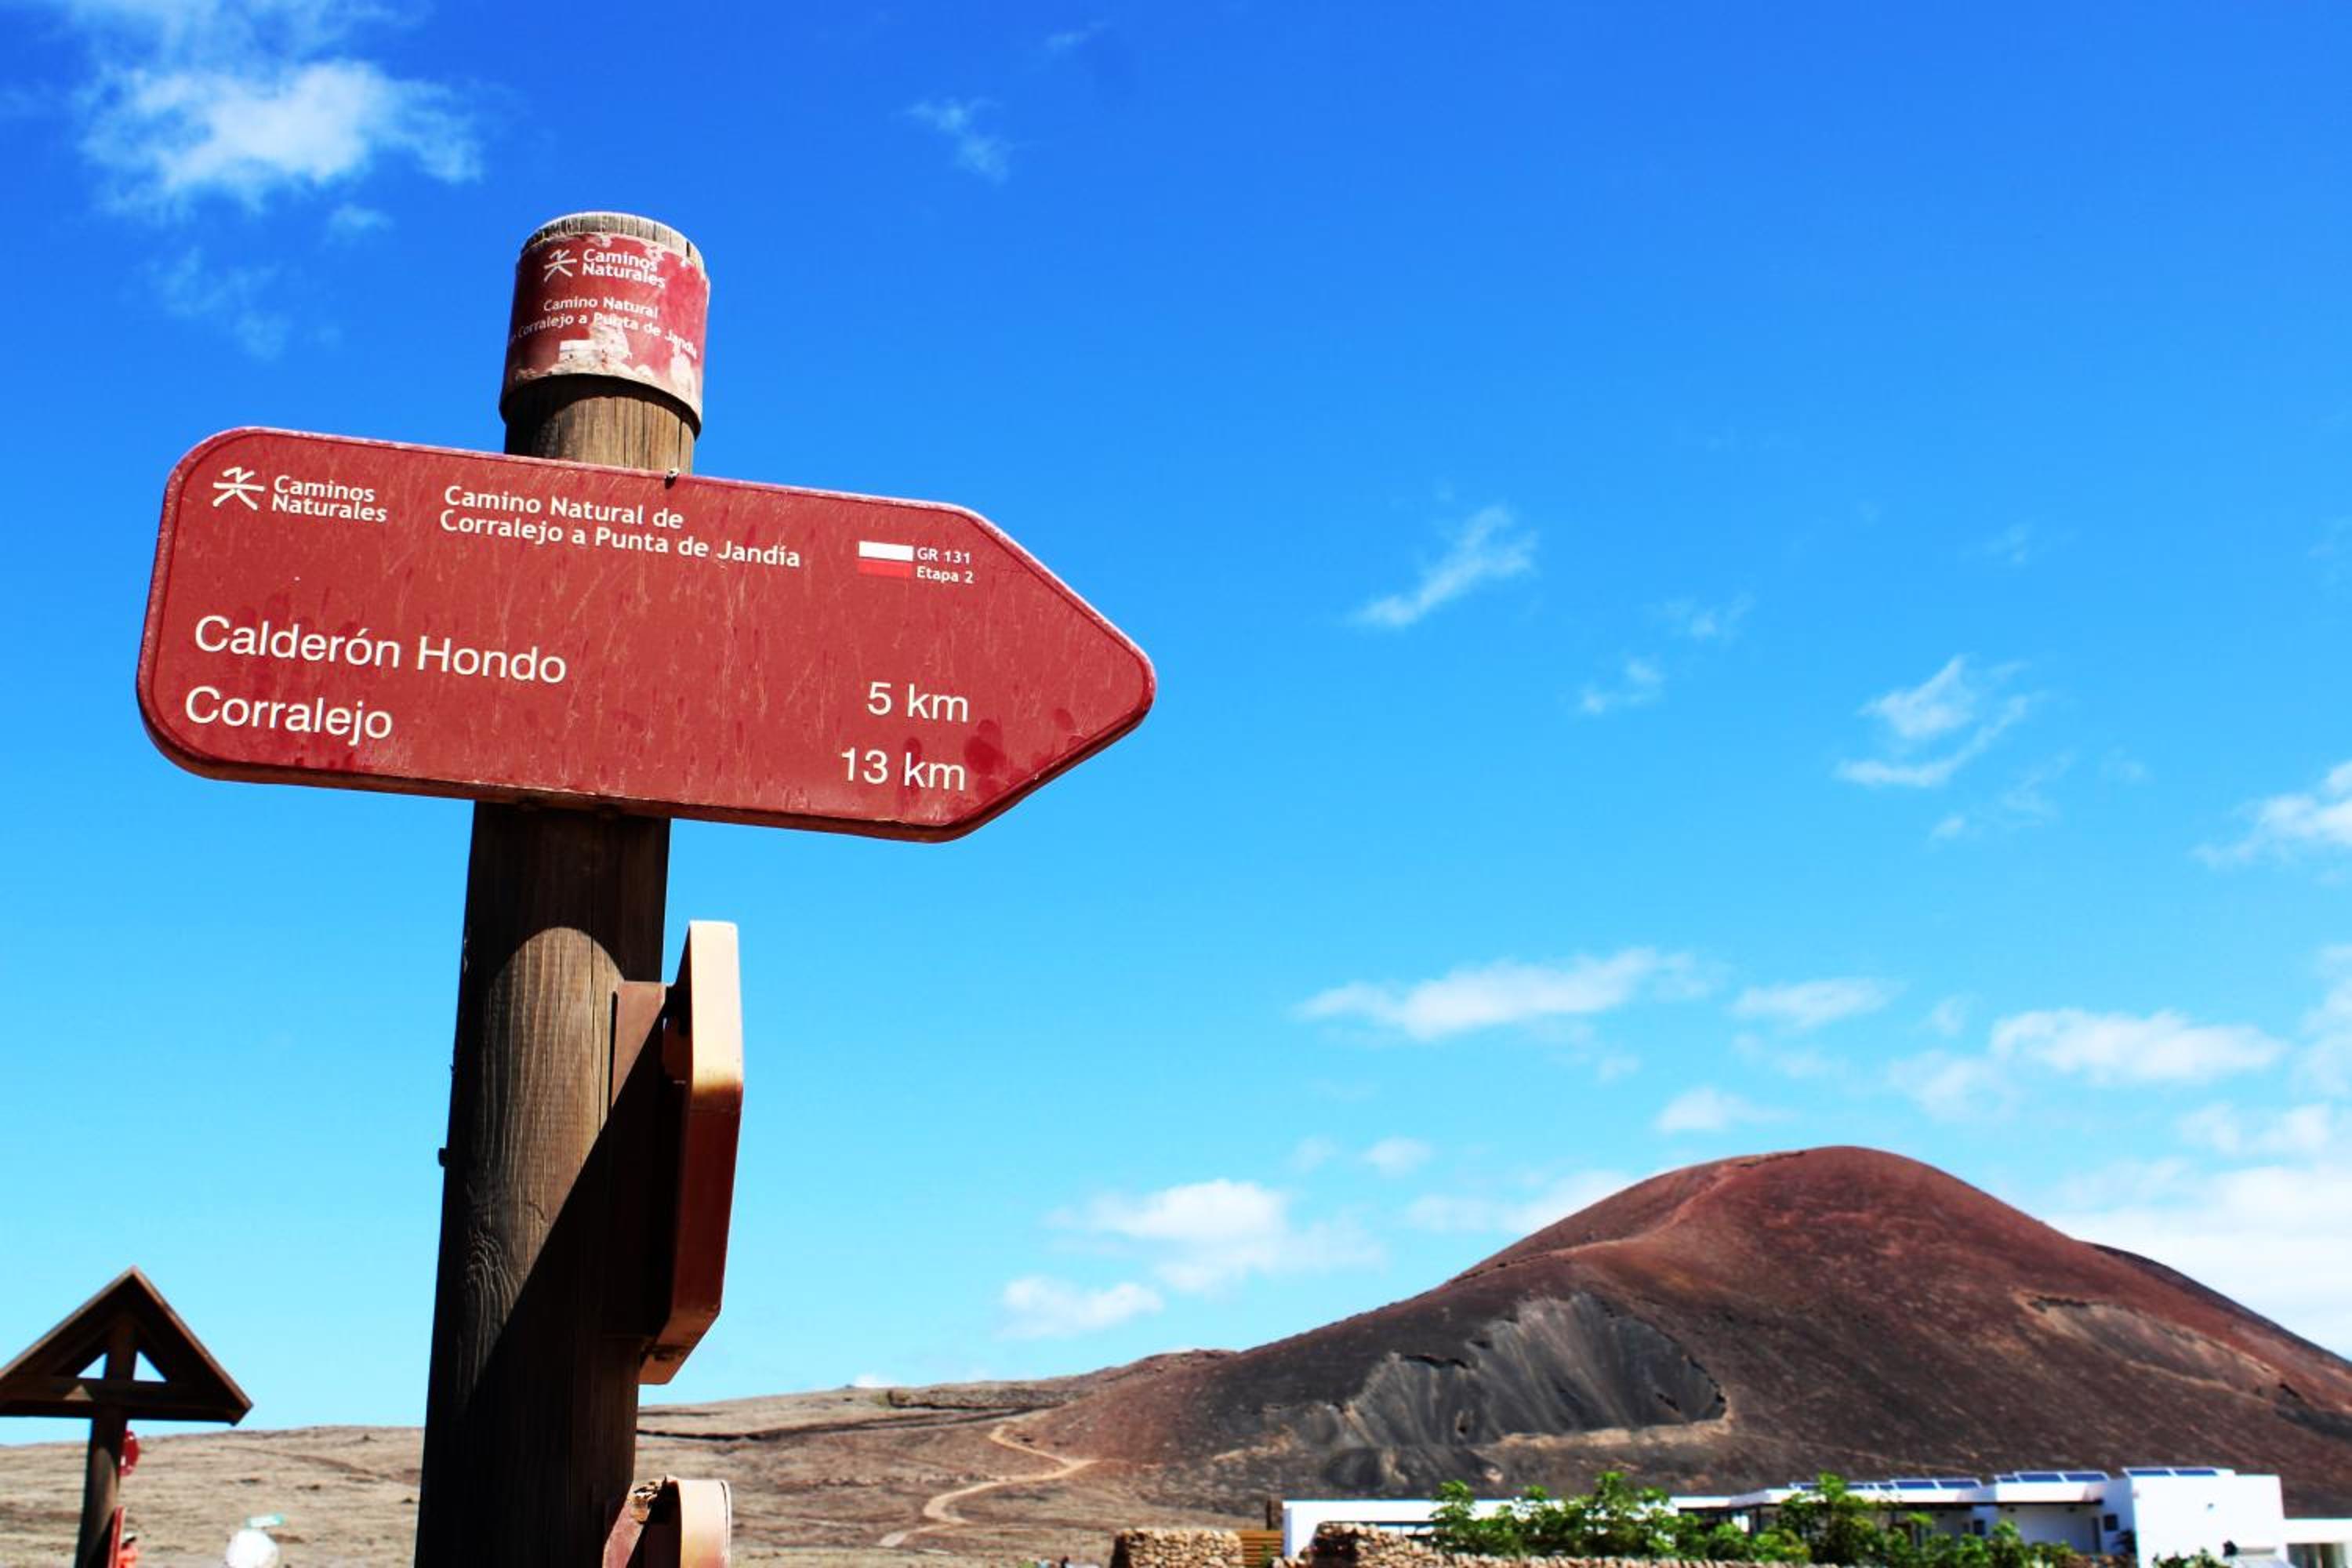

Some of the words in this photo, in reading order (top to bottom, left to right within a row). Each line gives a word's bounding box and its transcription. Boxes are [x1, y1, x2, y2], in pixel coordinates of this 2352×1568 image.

[583, 248, 658, 272] Caminos
[582, 263, 666, 289] Naturales
[543, 296, 598, 312] Camino
[603, 296, 658, 318] Natural
[518, 314, 575, 339] Corralejo
[578, 315, 587, 324] a
[593, 311, 638, 330] Punta
[644, 322, 661, 337] de
[274, 474, 376, 503] Caminos
[271, 493, 388, 523] Naturales
[444, 485, 542, 514] Camino
[550, 495, 644, 525] Natural
[652, 505, 684, 529] de
[440, 509, 564, 546] Corralejo
[571, 528, 586, 546] a
[594, 526, 670, 554] Punta
[677, 535, 710, 557] de
[716, 539, 800, 568] Jandía
[916, 546, 939, 563] GR
[943, 550, 971, 564] 131
[916, 565, 960, 584] Etapa
[964, 570, 974, 584] 2
[195, 615, 401, 669] Calderón
[416, 635, 567, 684] Hondo
[185, 685, 393, 746] Corralejo
[867, 681, 892, 717] 5
[907, 683, 968, 723] km
[840, 747, 888, 785] 13
[904, 752, 966, 791] km
